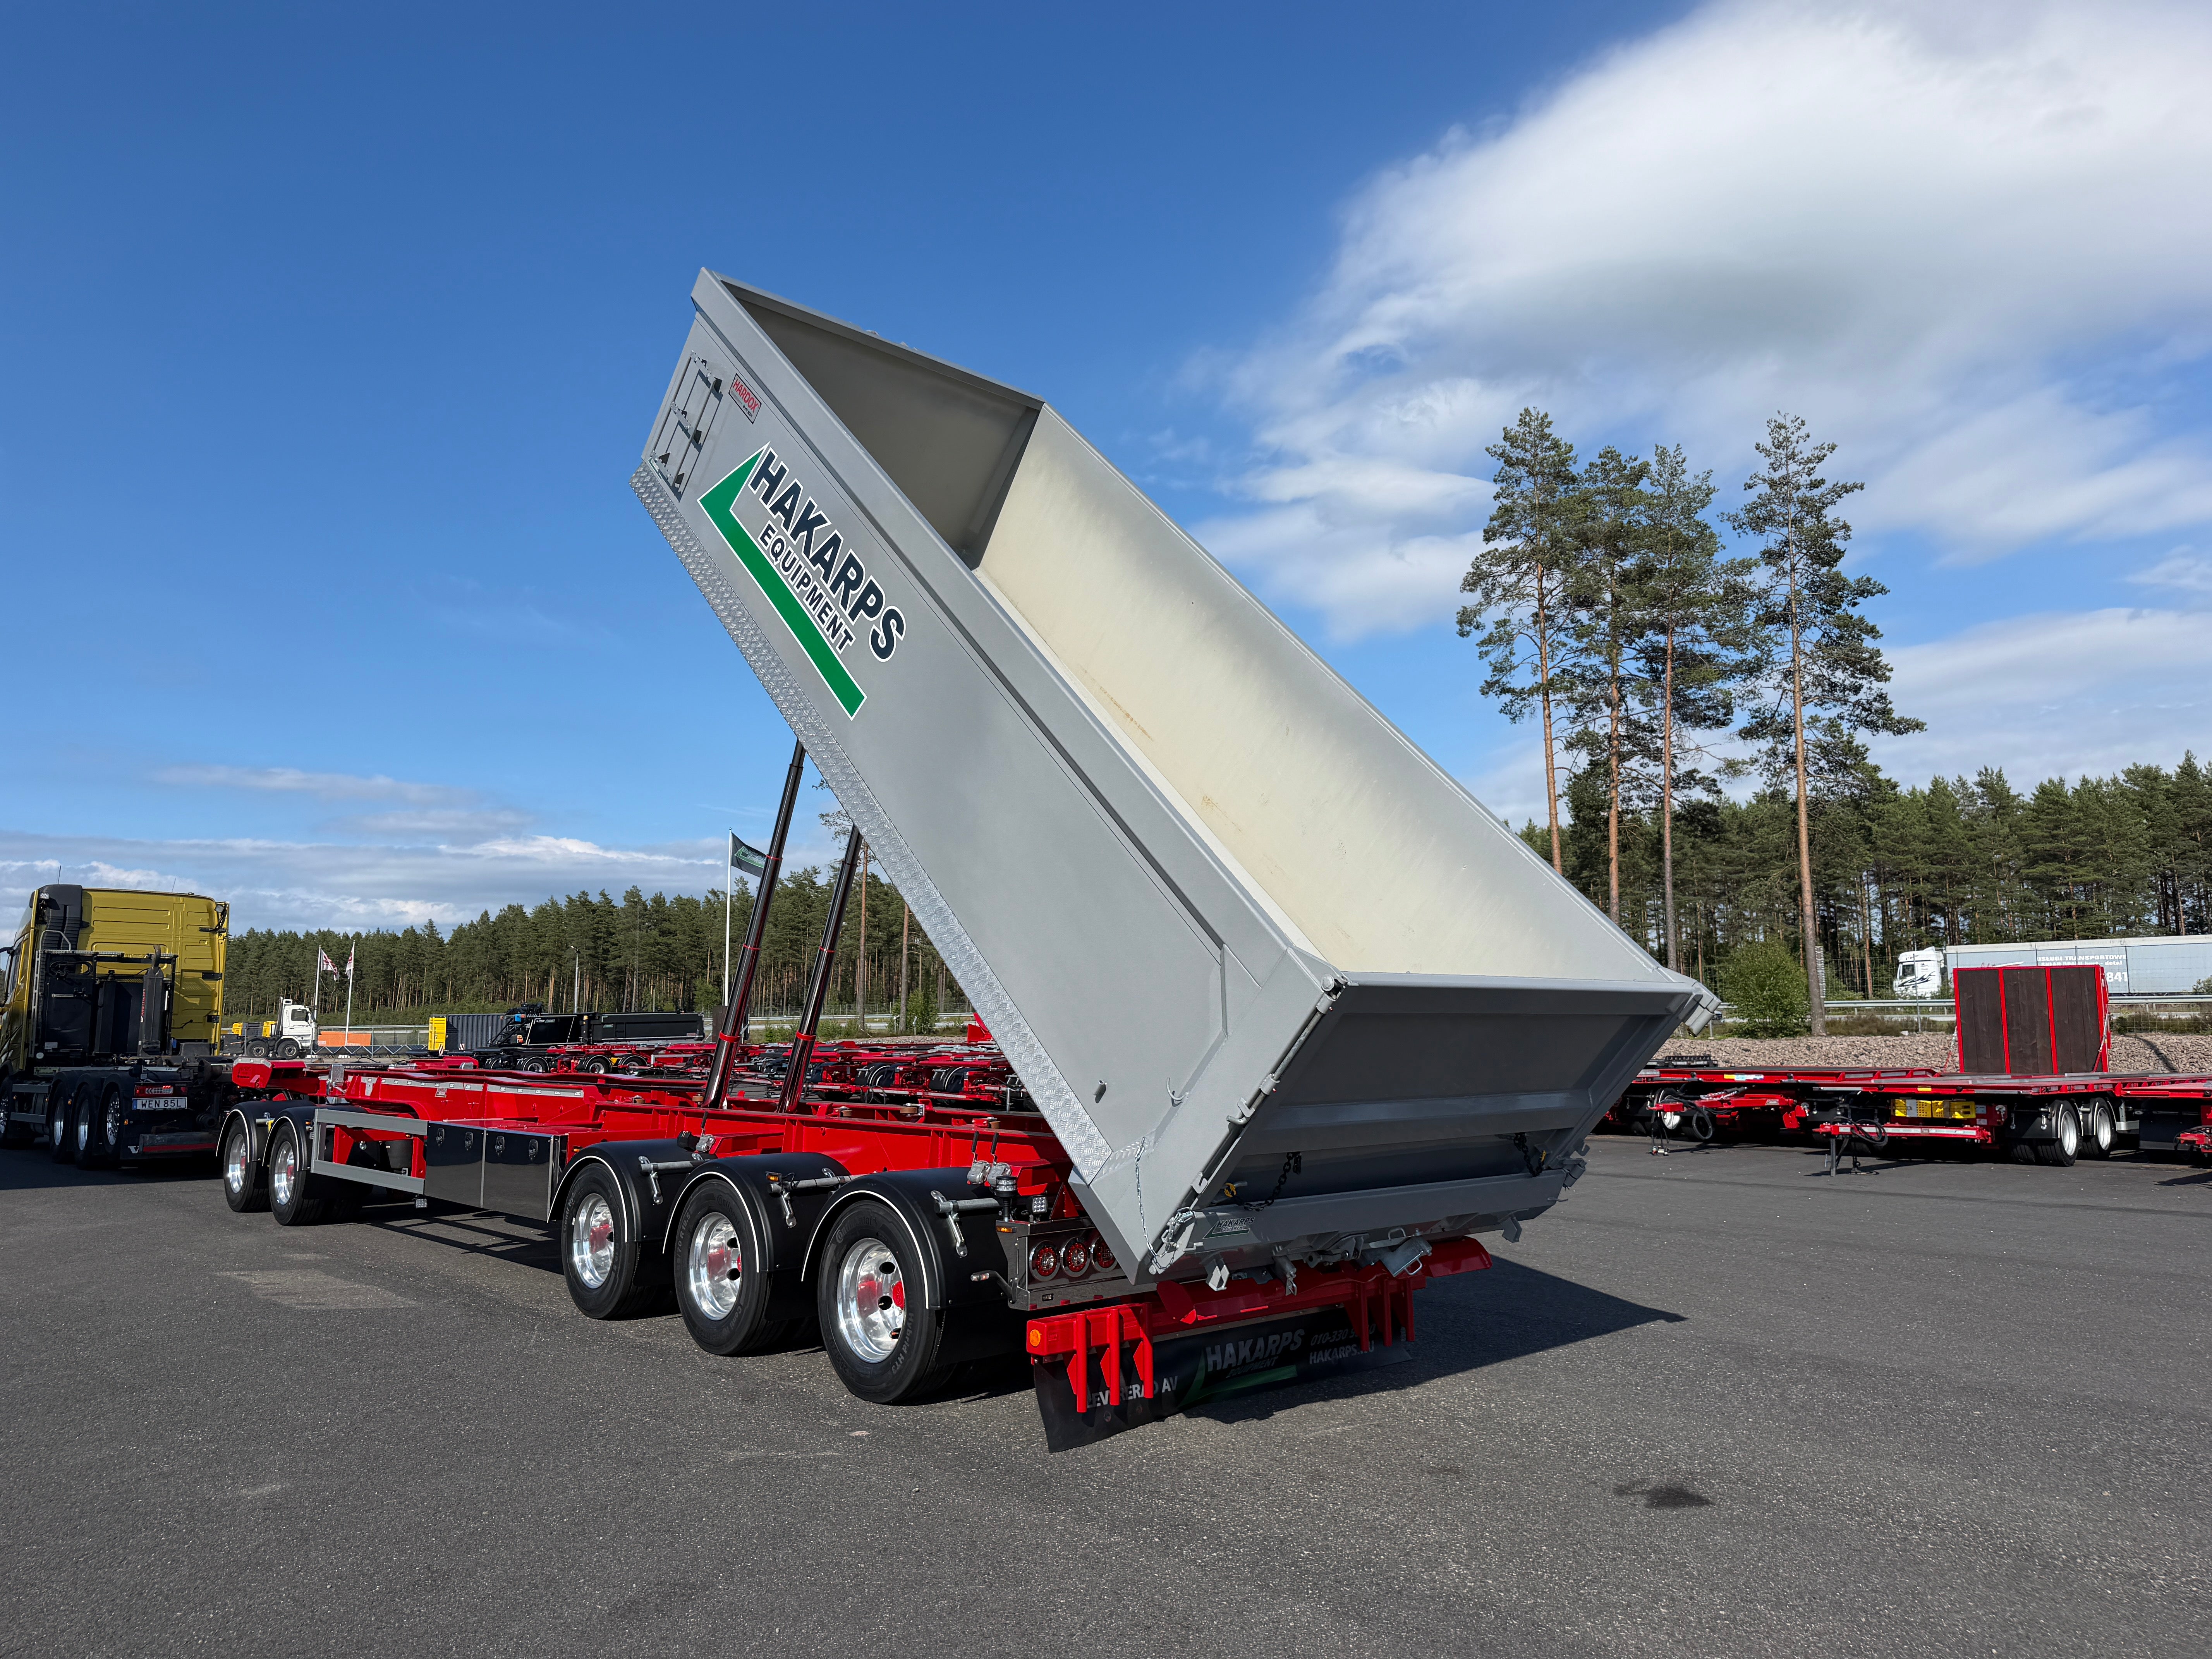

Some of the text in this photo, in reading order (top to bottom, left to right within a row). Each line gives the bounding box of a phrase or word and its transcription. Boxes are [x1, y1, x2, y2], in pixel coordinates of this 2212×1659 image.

[733, 379, 759, 413] HARDOX
[748, 447, 906, 662] HAKARPS
[757, 523, 855, 654] EQUIPMENT
[141, 1100, 160, 1108] WEN
[1216, 1217, 1255, 1228] HAKARPS
[891, 1312, 915, 1375] Hybrid HT3
[1310, 1328, 1348, 1346] 010-330
[1206, 1329, 1305, 1372] HAKARPS
[1309, 1340, 1375, 1365] HAKARPS.U
[1225, 1356, 1279, 1379] EQUIPMENT
[1162, 1376, 1178, 1393] AV
